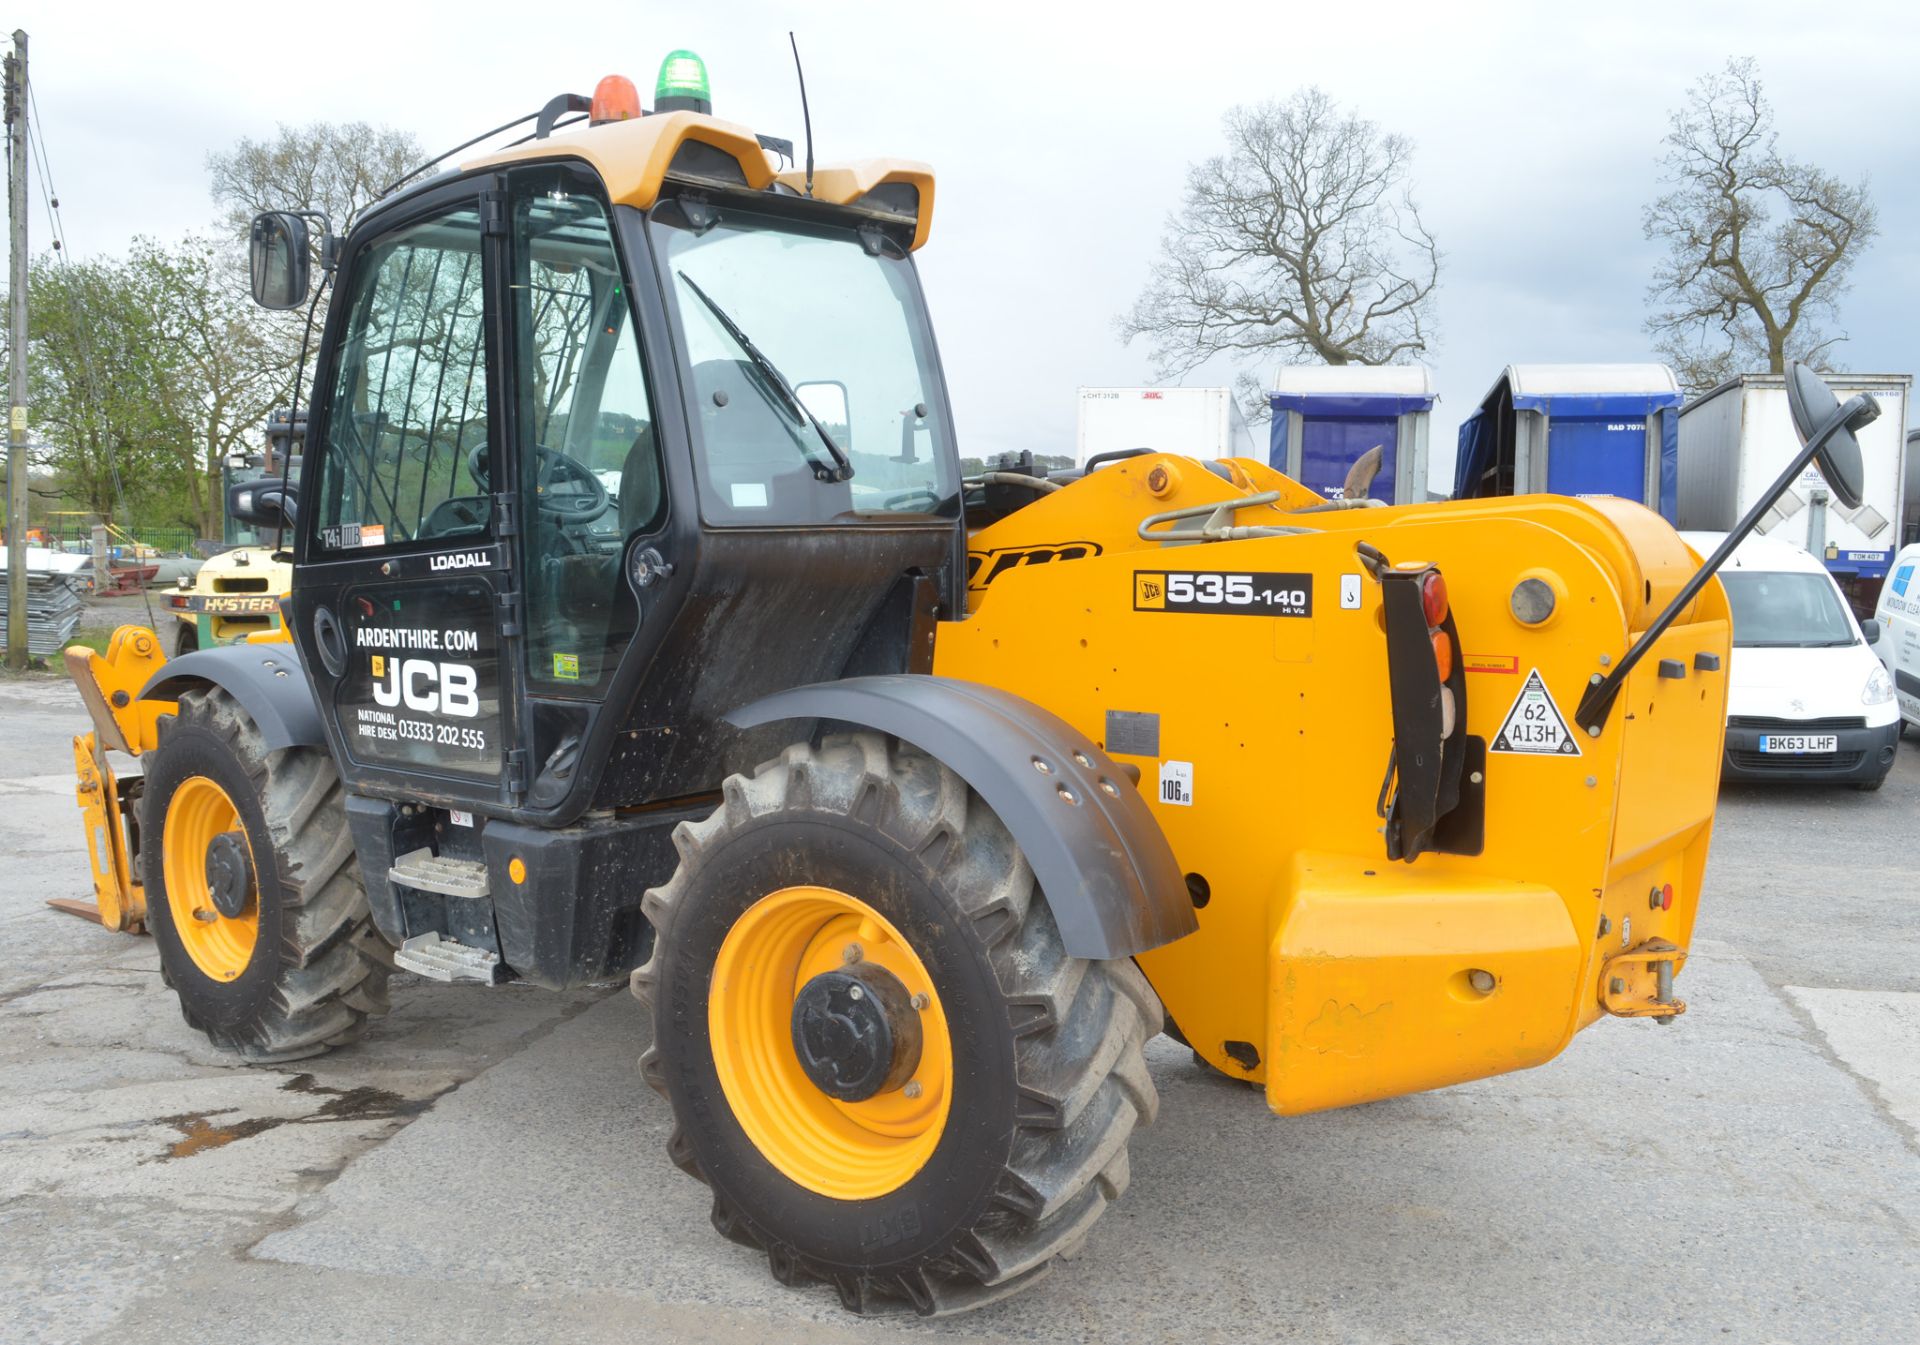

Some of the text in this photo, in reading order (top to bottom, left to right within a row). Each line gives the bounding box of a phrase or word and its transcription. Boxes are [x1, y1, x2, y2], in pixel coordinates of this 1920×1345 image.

[430, 552, 491, 570] LOADALL
[1143, 581, 1160, 599] JCB
[204, 598, 275, 611] HYSTER
[357, 628, 478, 651] ARDENTHIRE.COM
[373, 657, 479, 718] JCB
[357, 709, 397, 725] NATIONAL
[1524, 703, 1546, 721] 62
[358, 724, 398, 740] HIRE DESK
[398, 719, 485, 750] 03333 202 555
[1769, 737, 1834, 750] BK63 LHF
[1162, 779, 1182, 801] 106
